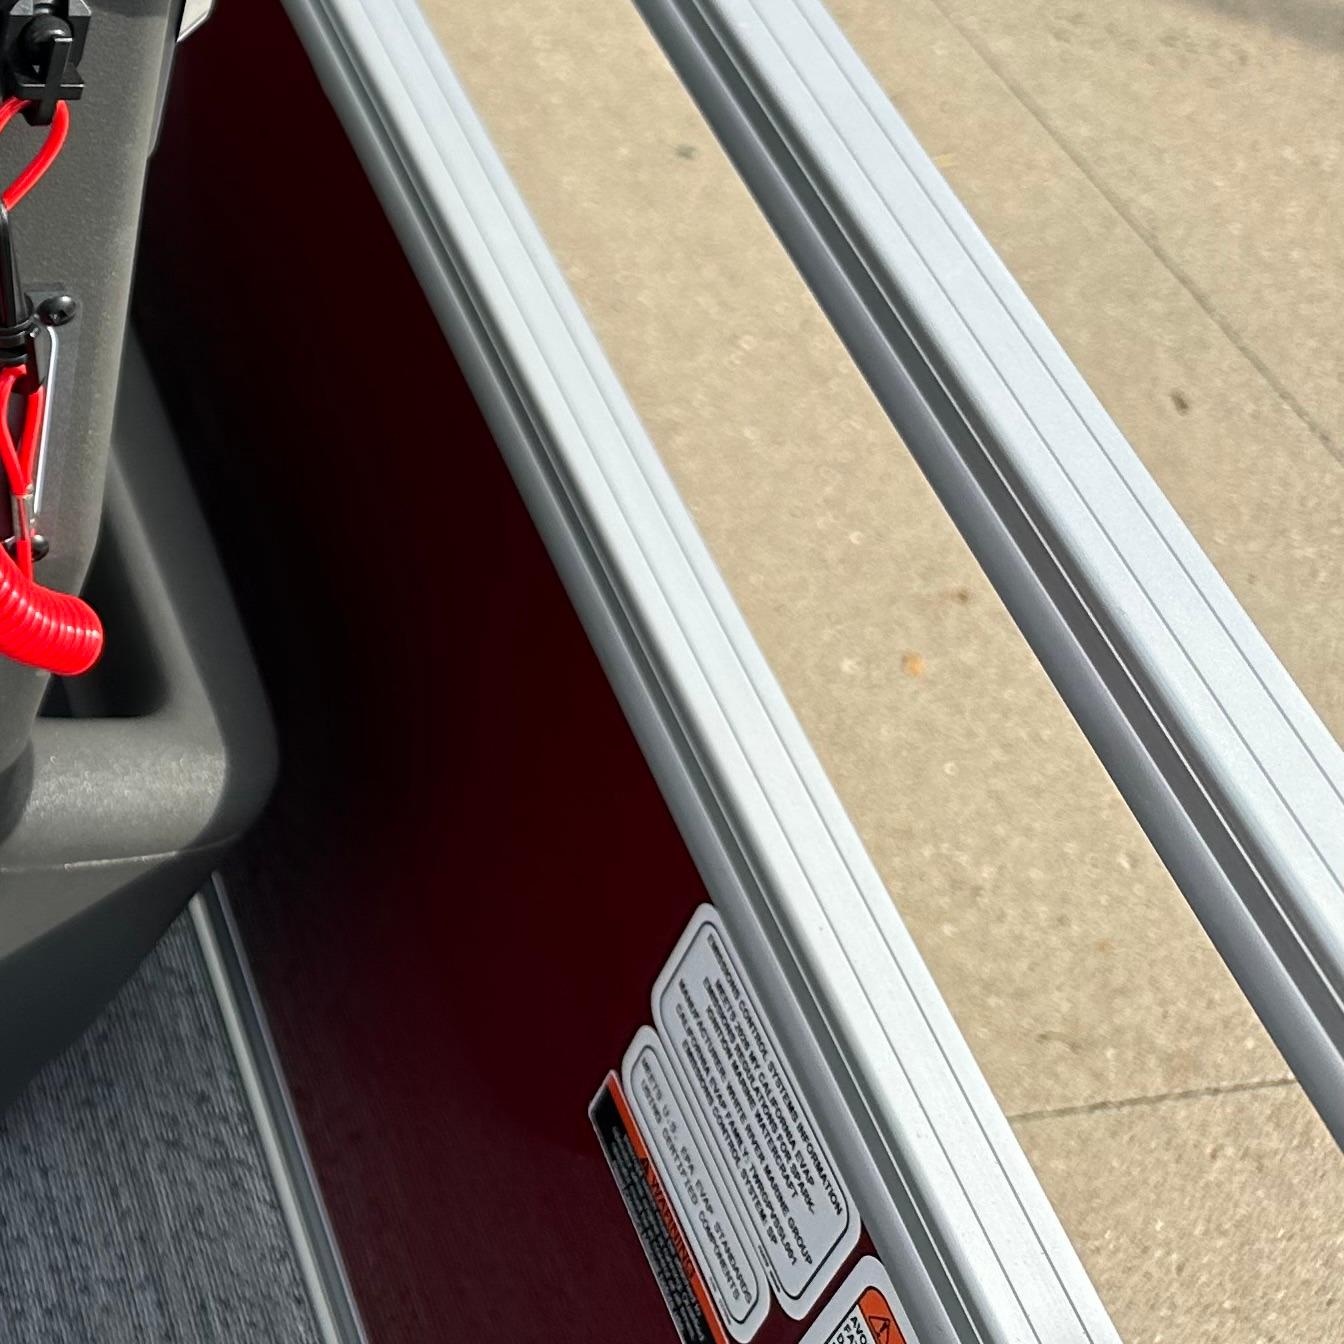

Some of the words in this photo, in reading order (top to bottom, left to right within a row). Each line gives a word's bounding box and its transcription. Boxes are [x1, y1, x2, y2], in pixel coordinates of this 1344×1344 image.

[708, 1075, 727, 1111] EVAP
[710, 1105, 743, 1169] CONTROL
[730, 1059, 757, 1111] MARINE
[753, 1108, 798, 1198] WATERCRAFT
[733, 1042, 778, 1134] REGULATIONS
[775, 1132, 792, 1163] FOR
[737, 998, 769, 1061] CONTROL
[766, 1060, 798, 1123] SYSTEMS
[796, 1122, 843, 1215] INFORMATION
[757, 1070, 797, 1150] CALIFORNIA
[794, 1149, 814, 1187] EVAP
[649, 1176, 695, 1278] WARNING
[679, 1145, 696, 1175] EPA
[712, 1220, 753, 1305] STANDARDS
[724, 1081, 747, 1124] WHITE
[743, 1122, 766, 1164] RIVER
[762, 1164, 790, 1217] MARINE
[786, 1215, 812, 1266] GROUP
[850, 1316, 867, 1344] AVO
